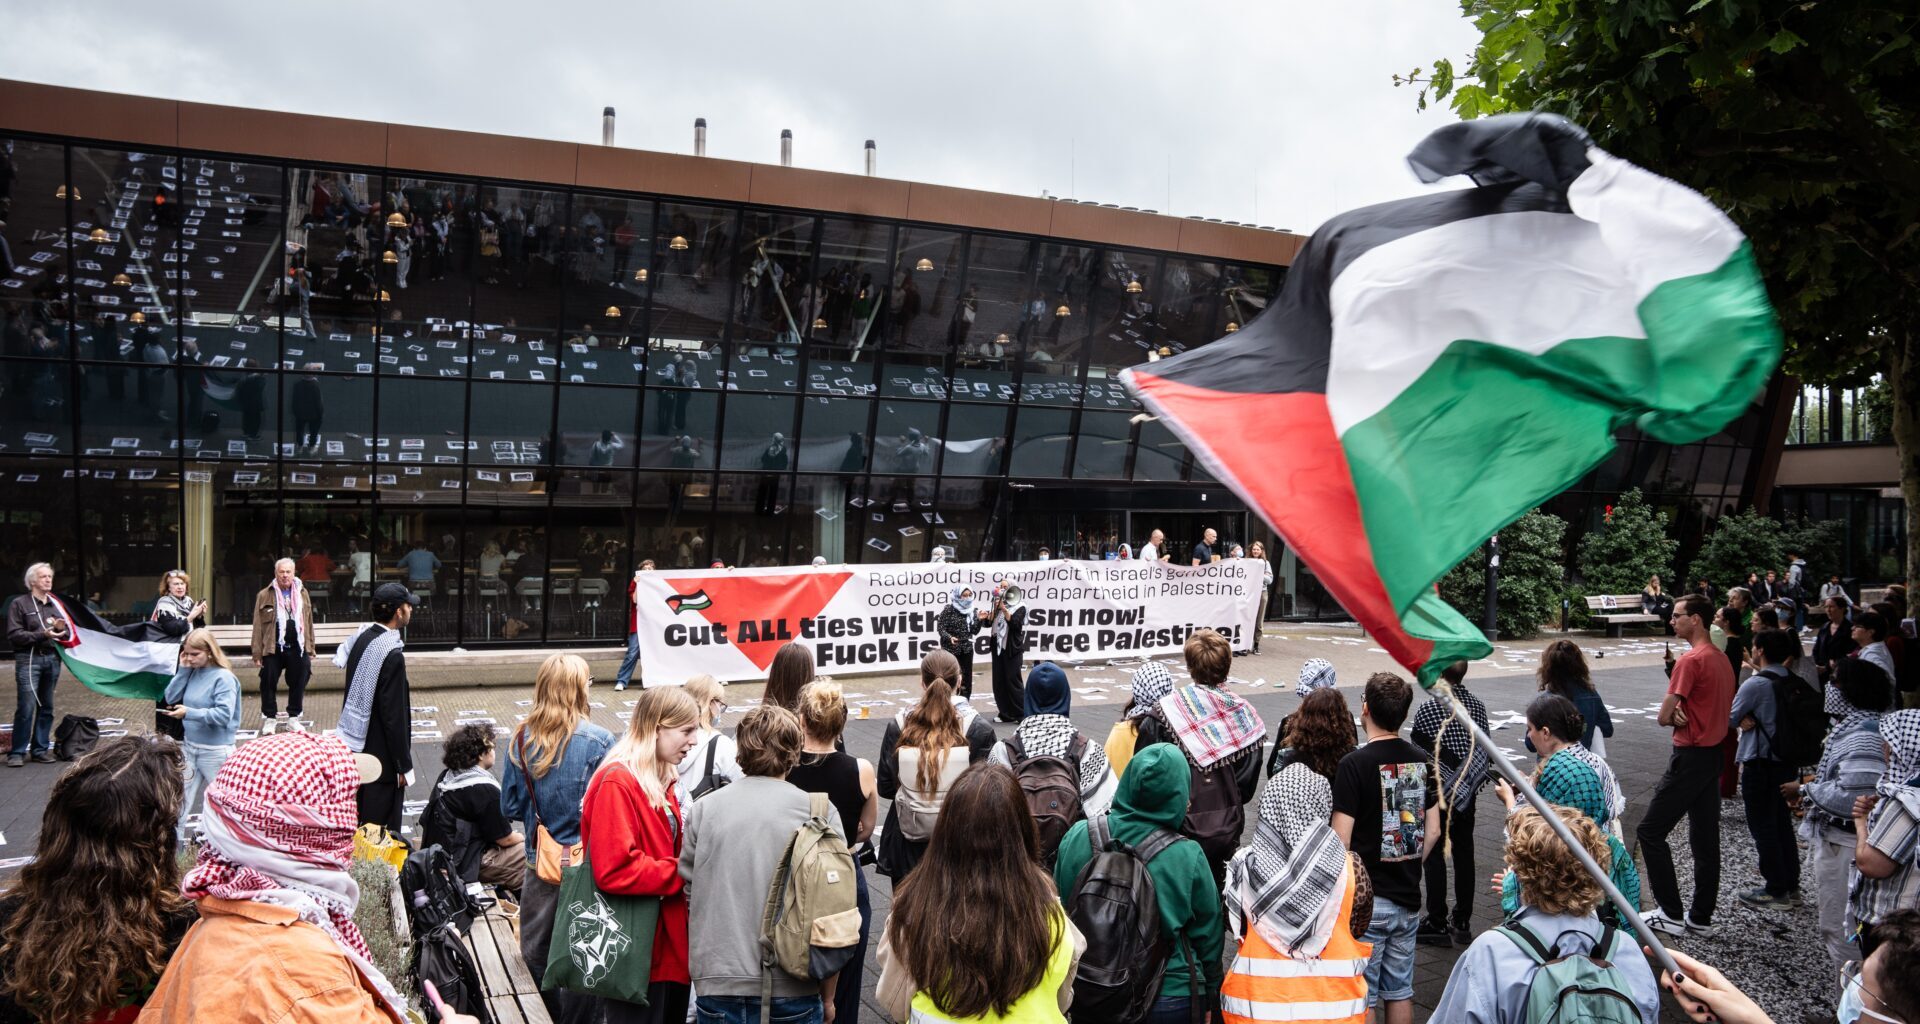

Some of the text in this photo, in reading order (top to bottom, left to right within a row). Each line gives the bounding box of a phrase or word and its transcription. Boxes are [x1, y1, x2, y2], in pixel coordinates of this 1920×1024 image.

[869, 568, 961, 587] Radboud
[969, 569, 985, 583] is
[1086, 567, 1100, 581] in
[1105, 566, 1162, 581] israel's
[1047, 584, 1139, 601] apartheid
[1144, 584, 1156, 598] in
[1161, 582, 1246, 597] Palestine.
[664, 622, 728, 646] Cut
[737, 618, 791, 643] ALL
[800, 615, 863, 638] ties
[871, 611, 939, 635] with
[1079, 605, 1145, 626] now!
[817, 638, 899, 667] Fuck
[1023, 630, 1090, 653] Free
[1097, 624, 1241, 651] Palestie!
